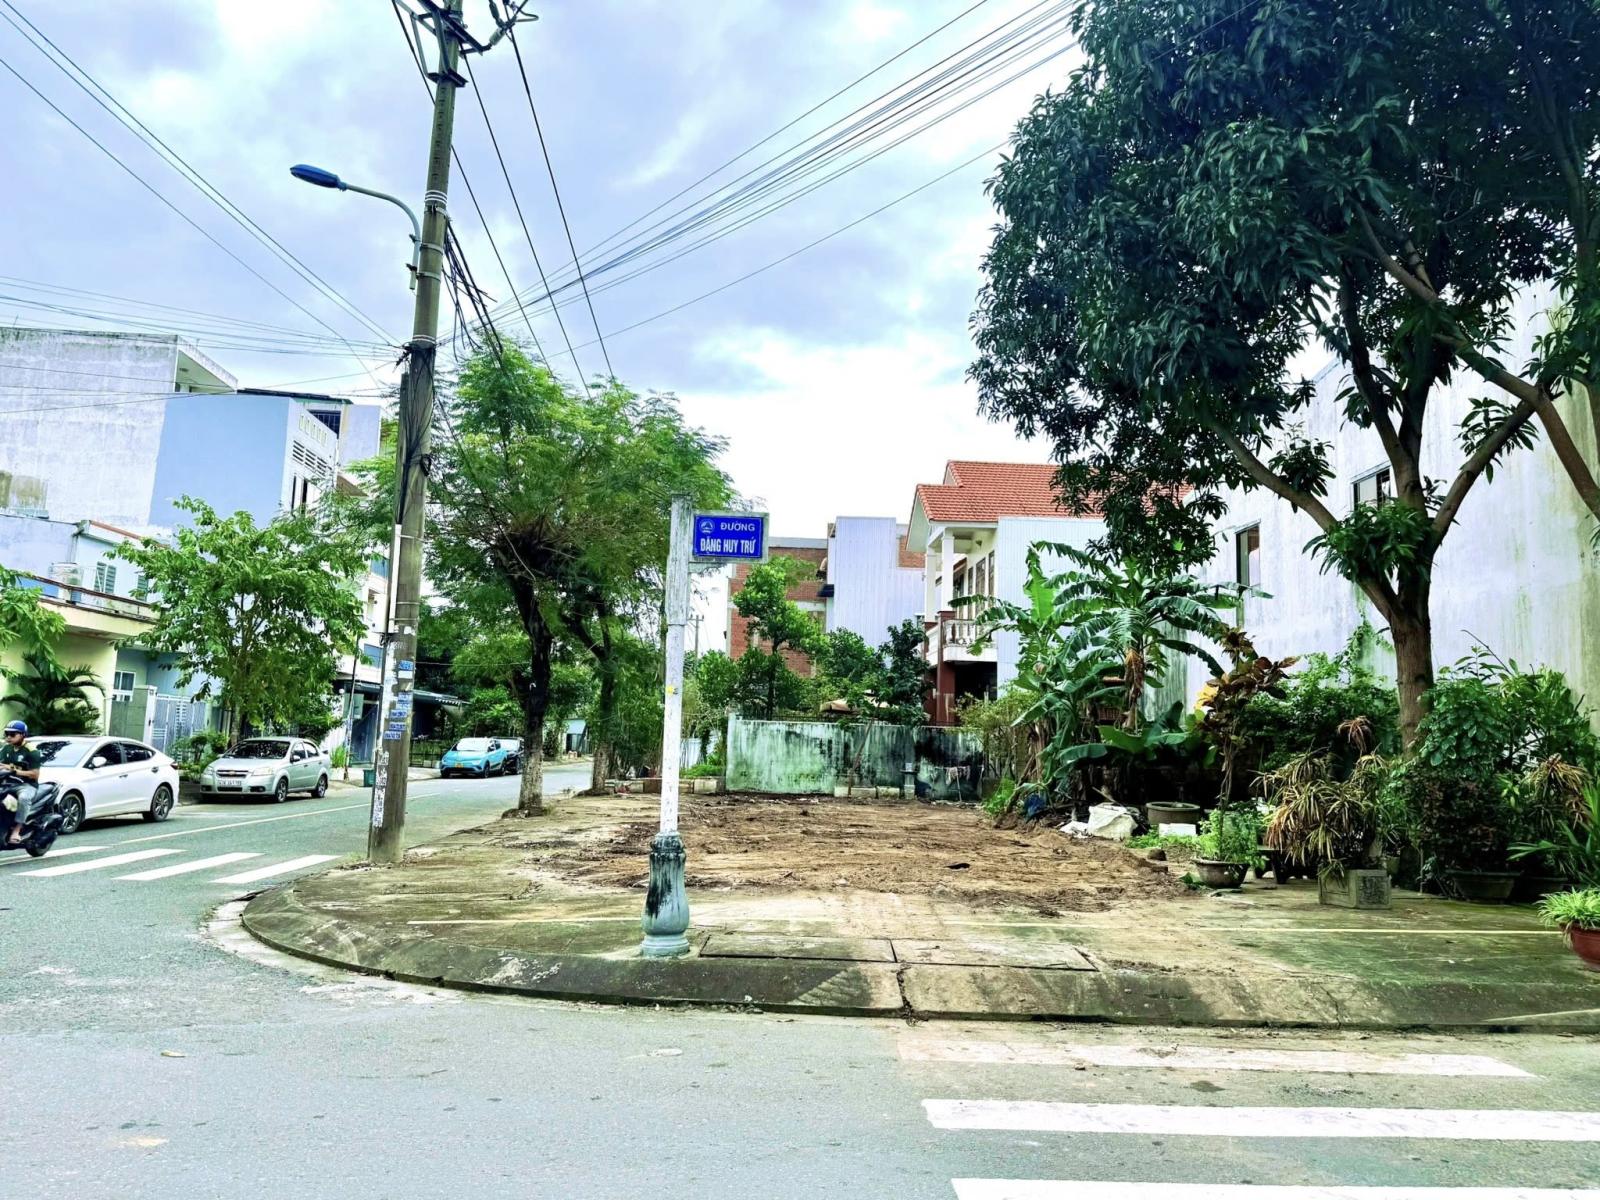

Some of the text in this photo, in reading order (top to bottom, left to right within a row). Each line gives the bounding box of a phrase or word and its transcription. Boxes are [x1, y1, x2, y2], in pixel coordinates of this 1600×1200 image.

[720, 520, 755, 532] ĐƯỜNG
[700, 536, 756, 554] ĐẶNG HUY TRỨ
